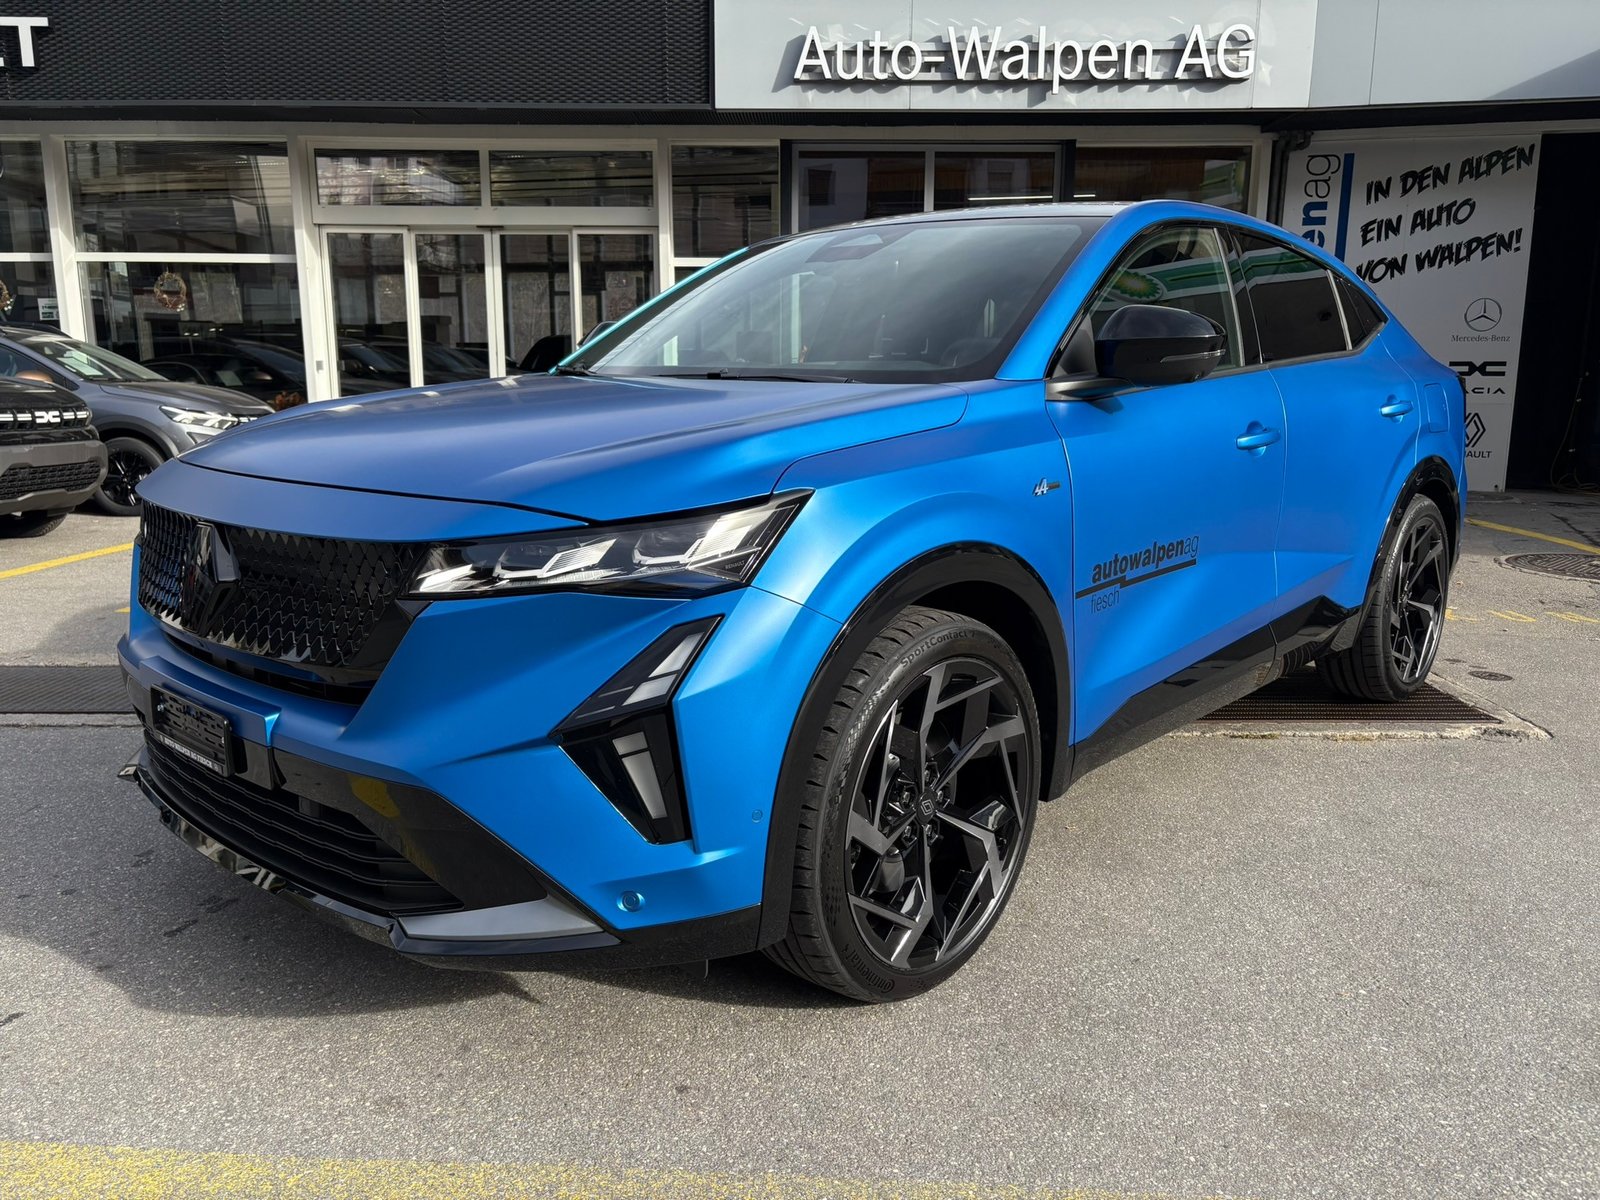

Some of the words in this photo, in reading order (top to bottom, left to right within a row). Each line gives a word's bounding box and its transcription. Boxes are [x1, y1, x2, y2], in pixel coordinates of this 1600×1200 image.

[0, 17, 48, 67] T
[794, 26, 1152, 94] Auto-Walpen
[1175, 24, 1255, 79] AG
[1366, 176, 1392, 205] IN
[1400, 163, 1450, 198] DEN
[1458, 143, 1535, 184] ALPEN
[1360, 215, 1402, 247] EIN
[1410, 197, 1476, 236] AUTO
[1356, 254, 1408, 283] VON
[1415, 228, 1523, 273] WALPEN!
[1451, 334, 1511, 343] Mercedes-Benz
[1466, 450, 1492, 458] AULT
[1091, 535, 1199, 584] autowalpenag
[1090, 588, 1120, 614] fiesch
[900, 630, 967, 668] SportContact
